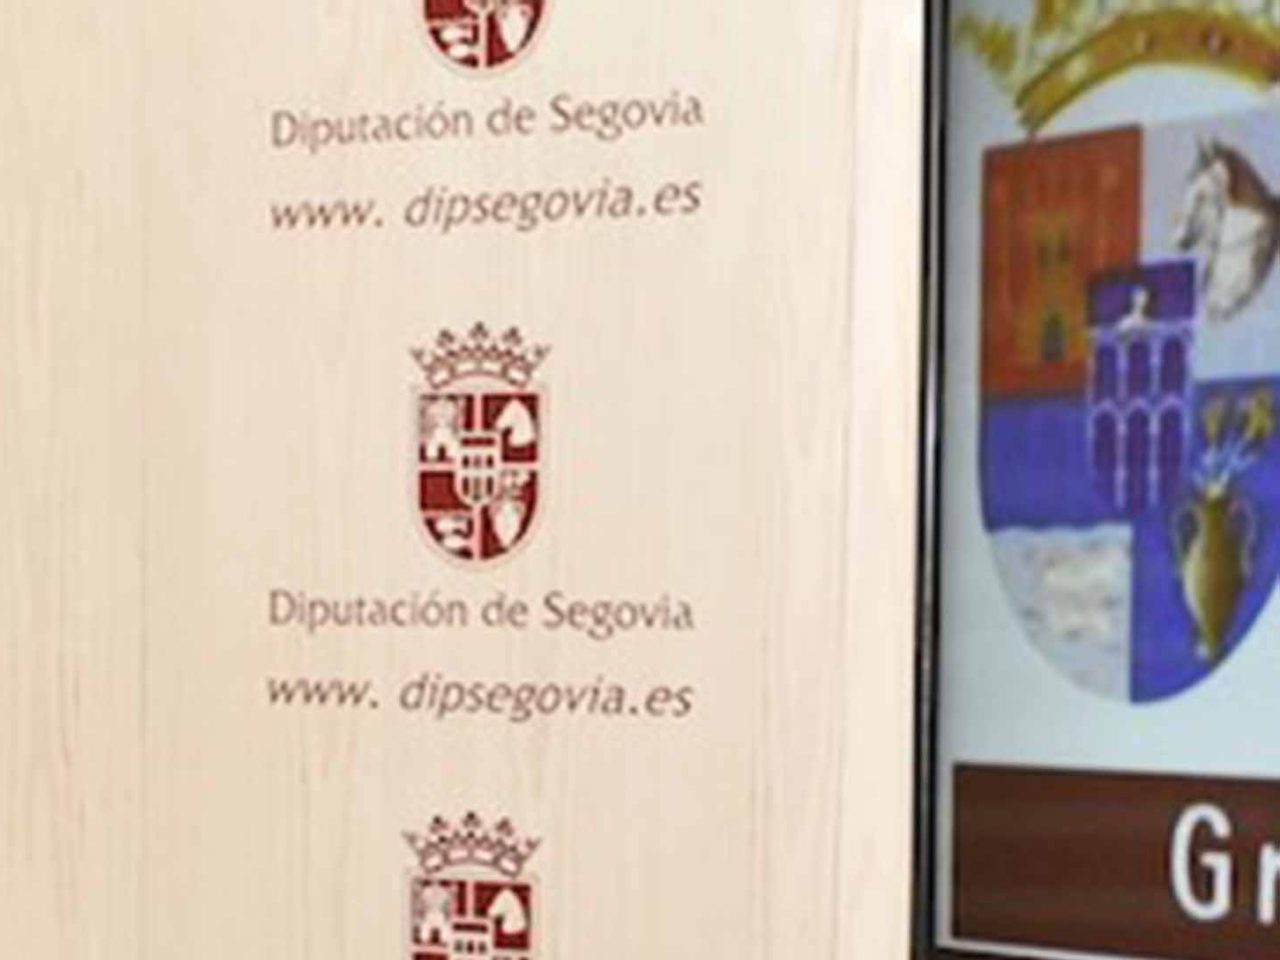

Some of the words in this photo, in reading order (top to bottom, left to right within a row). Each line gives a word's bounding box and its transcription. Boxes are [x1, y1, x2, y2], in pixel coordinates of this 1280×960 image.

[271, 101, 473, 152] Diputación
[487, 98, 537, 136] de
[549, 90, 704, 140] Segovia
[270, 200, 383, 230] www.
[404, 178, 702, 232] dipsegovia.es
[269, 589, 467, 633] Diputación
[482, 590, 529, 628] de
[543, 589, 695, 640] Segovia
[267, 676, 379, 709] www.
[399, 672, 694, 723] dipsegovia.es
[1172, 802, 1280, 926] Gr
